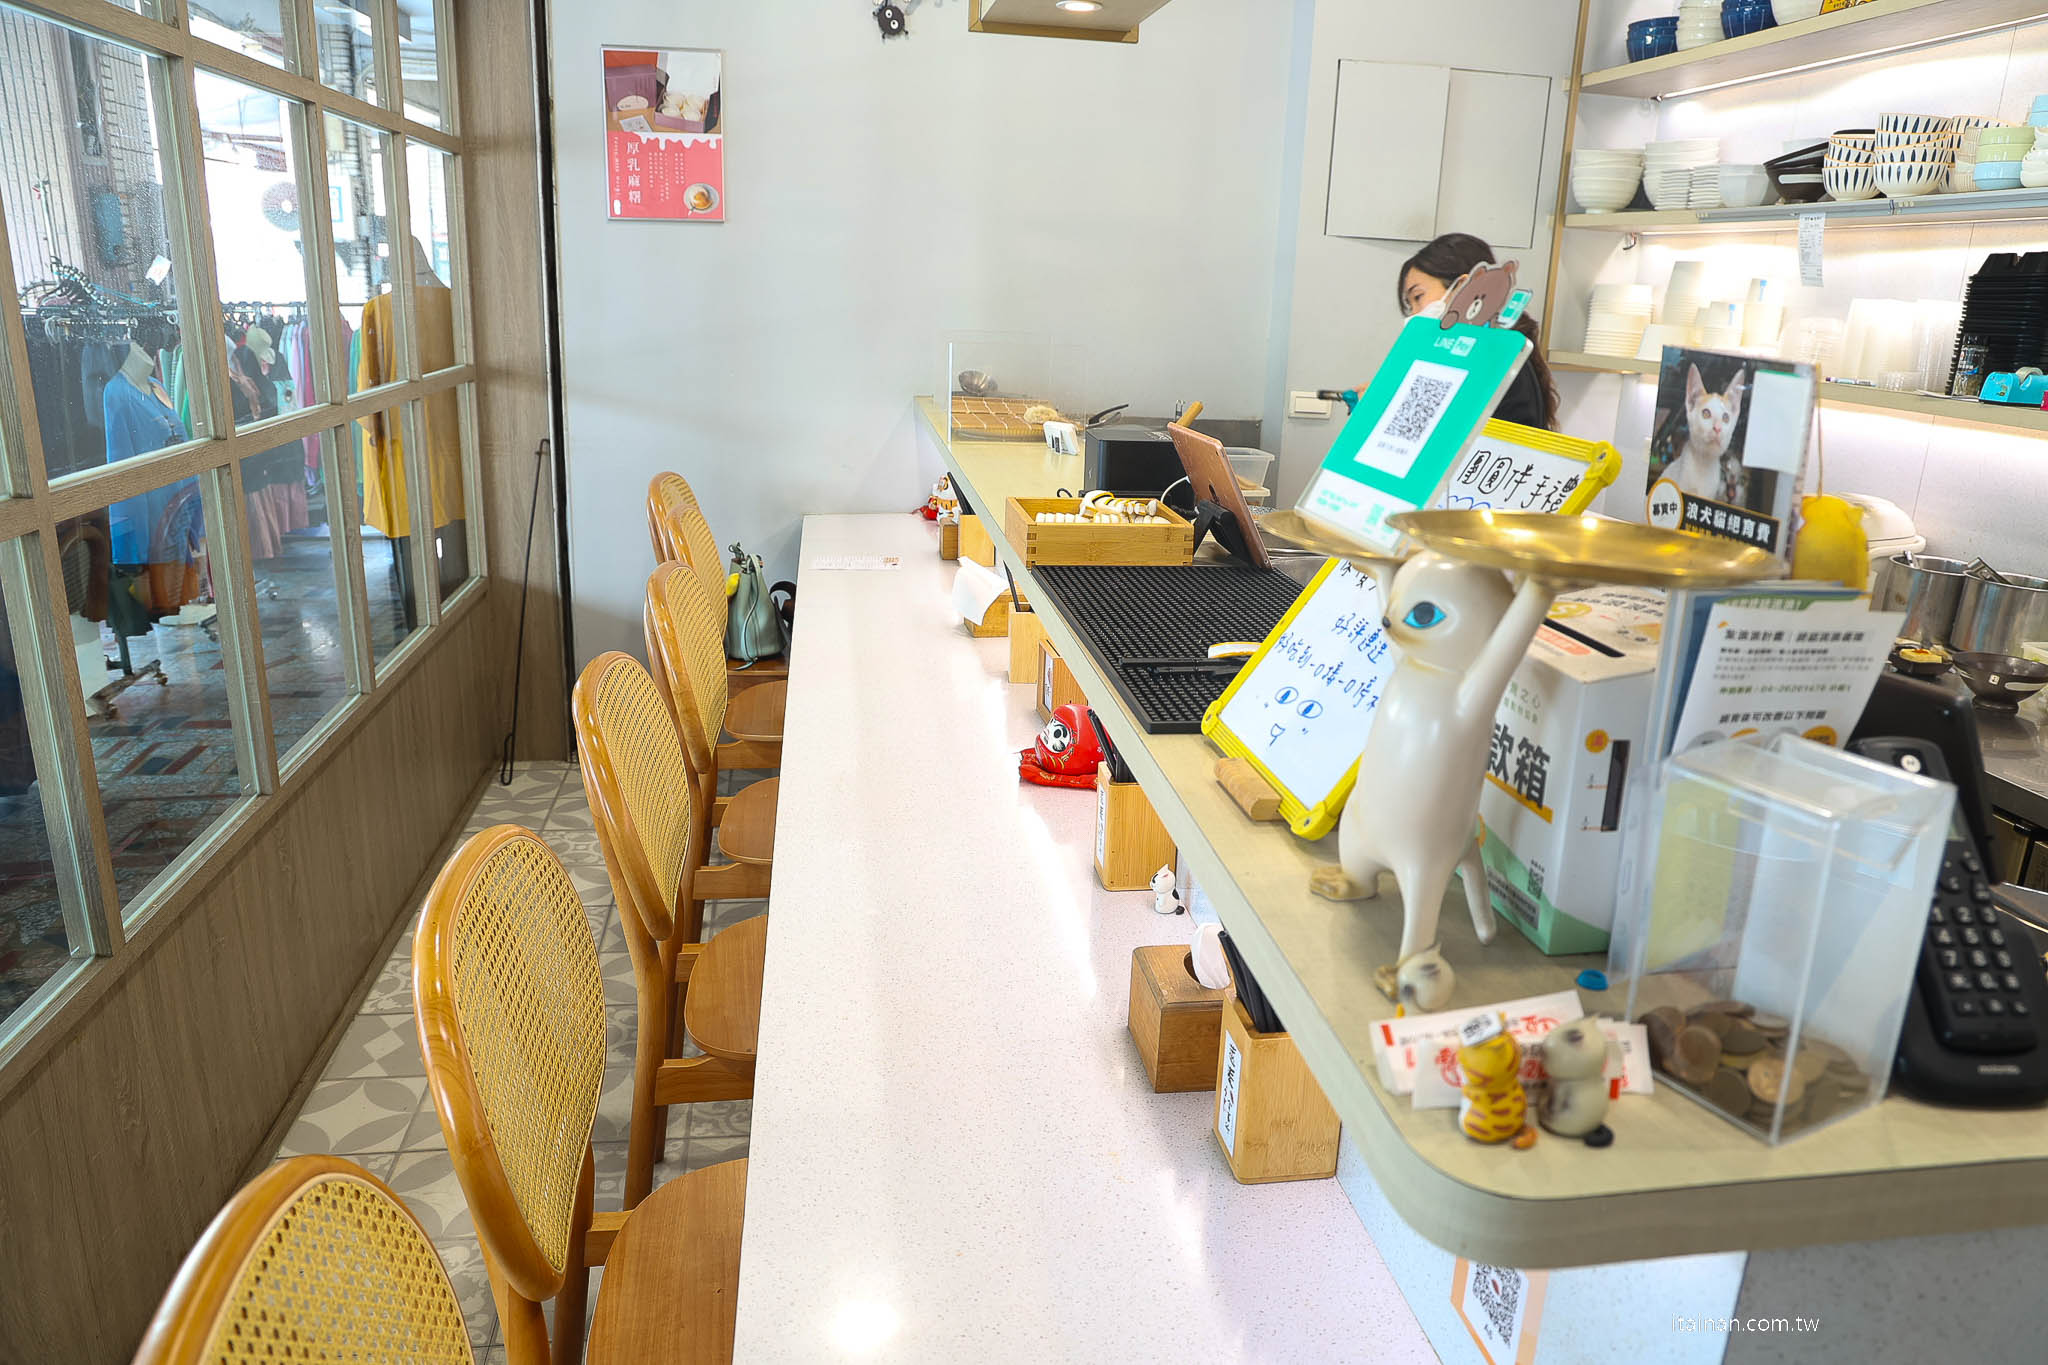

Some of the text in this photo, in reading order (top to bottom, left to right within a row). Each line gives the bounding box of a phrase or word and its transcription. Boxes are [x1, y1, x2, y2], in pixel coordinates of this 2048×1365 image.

[1433, 336, 1456, 349] LINE
[1457, 449, 1580, 513] 團圓伴手禮
[1652, 502, 1678, 516] 募資中
[1686, 501, 1771, 544] 浪犬貓絕育費
[1487, 723, 1550, 810] 款箱
